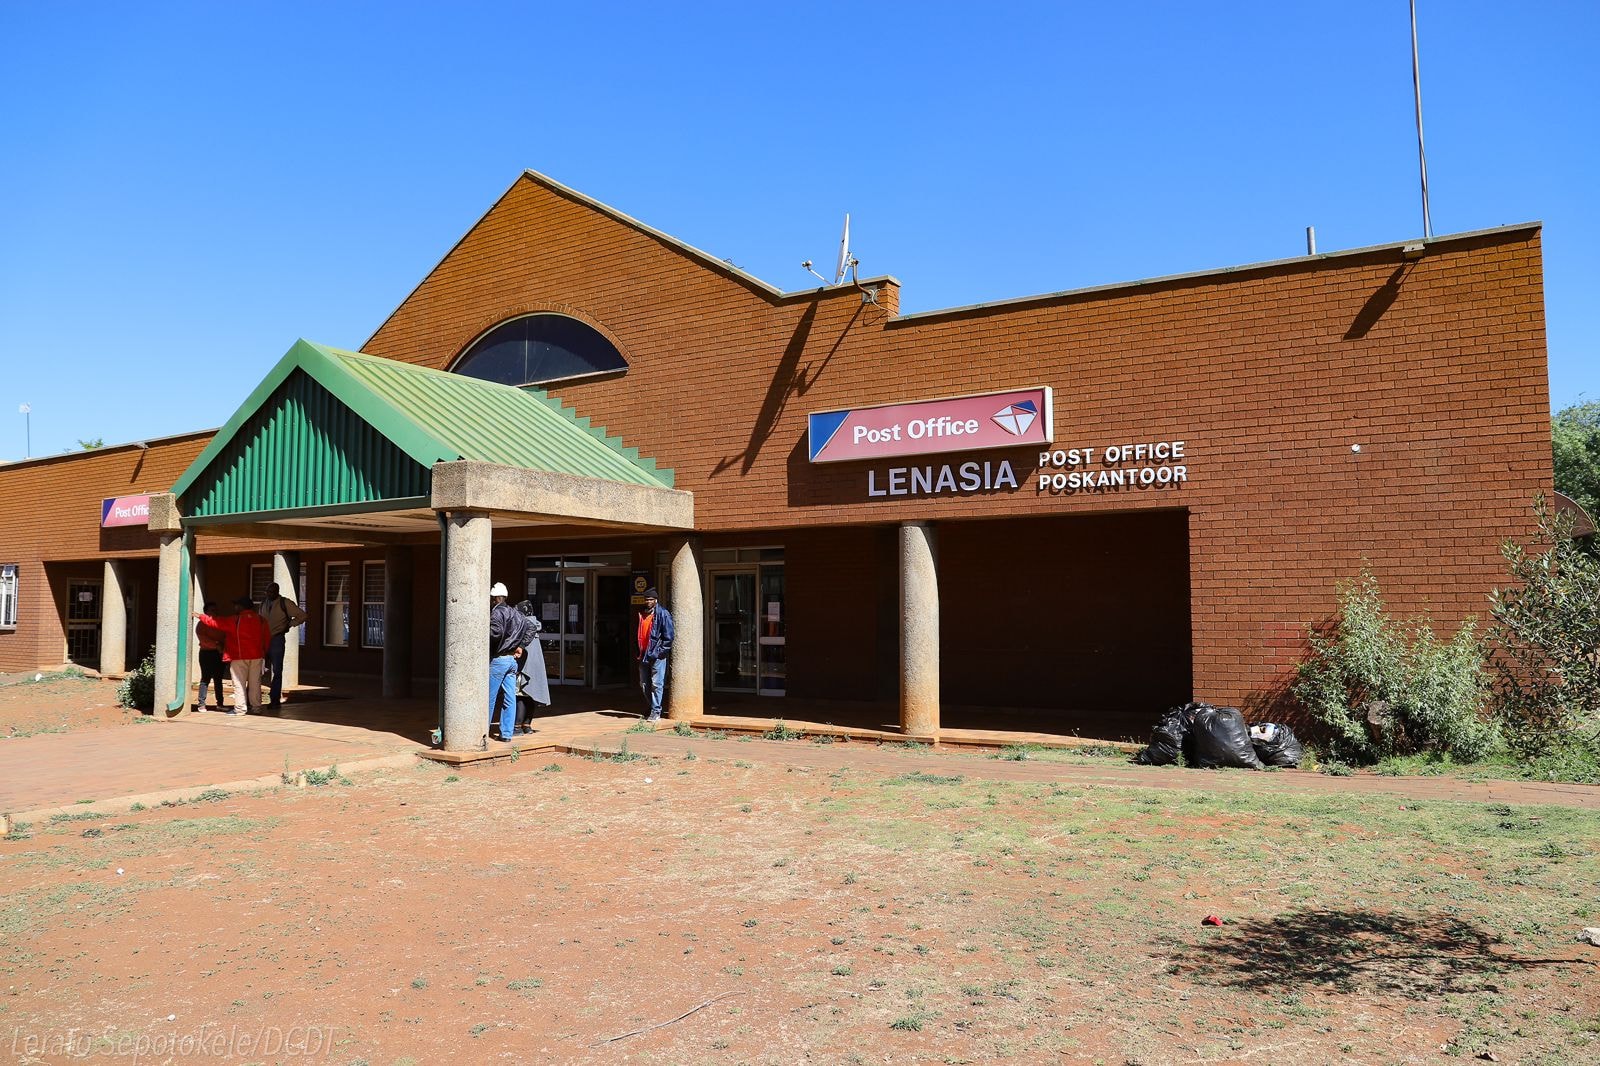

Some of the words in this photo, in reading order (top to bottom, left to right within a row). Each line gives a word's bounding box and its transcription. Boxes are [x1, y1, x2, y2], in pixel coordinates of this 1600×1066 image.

[853, 424, 902, 445] Post
[907, 416, 979, 439] Office
[1039, 448, 1094, 467] POST
[1105, 441, 1185, 462] OFFICE
[868, 460, 1018, 497] LENASIA
[1039, 465, 1188, 490] POSKANTOOR
[115, 507, 131, 518] Post
[131, 504, 149, 516] Offic
